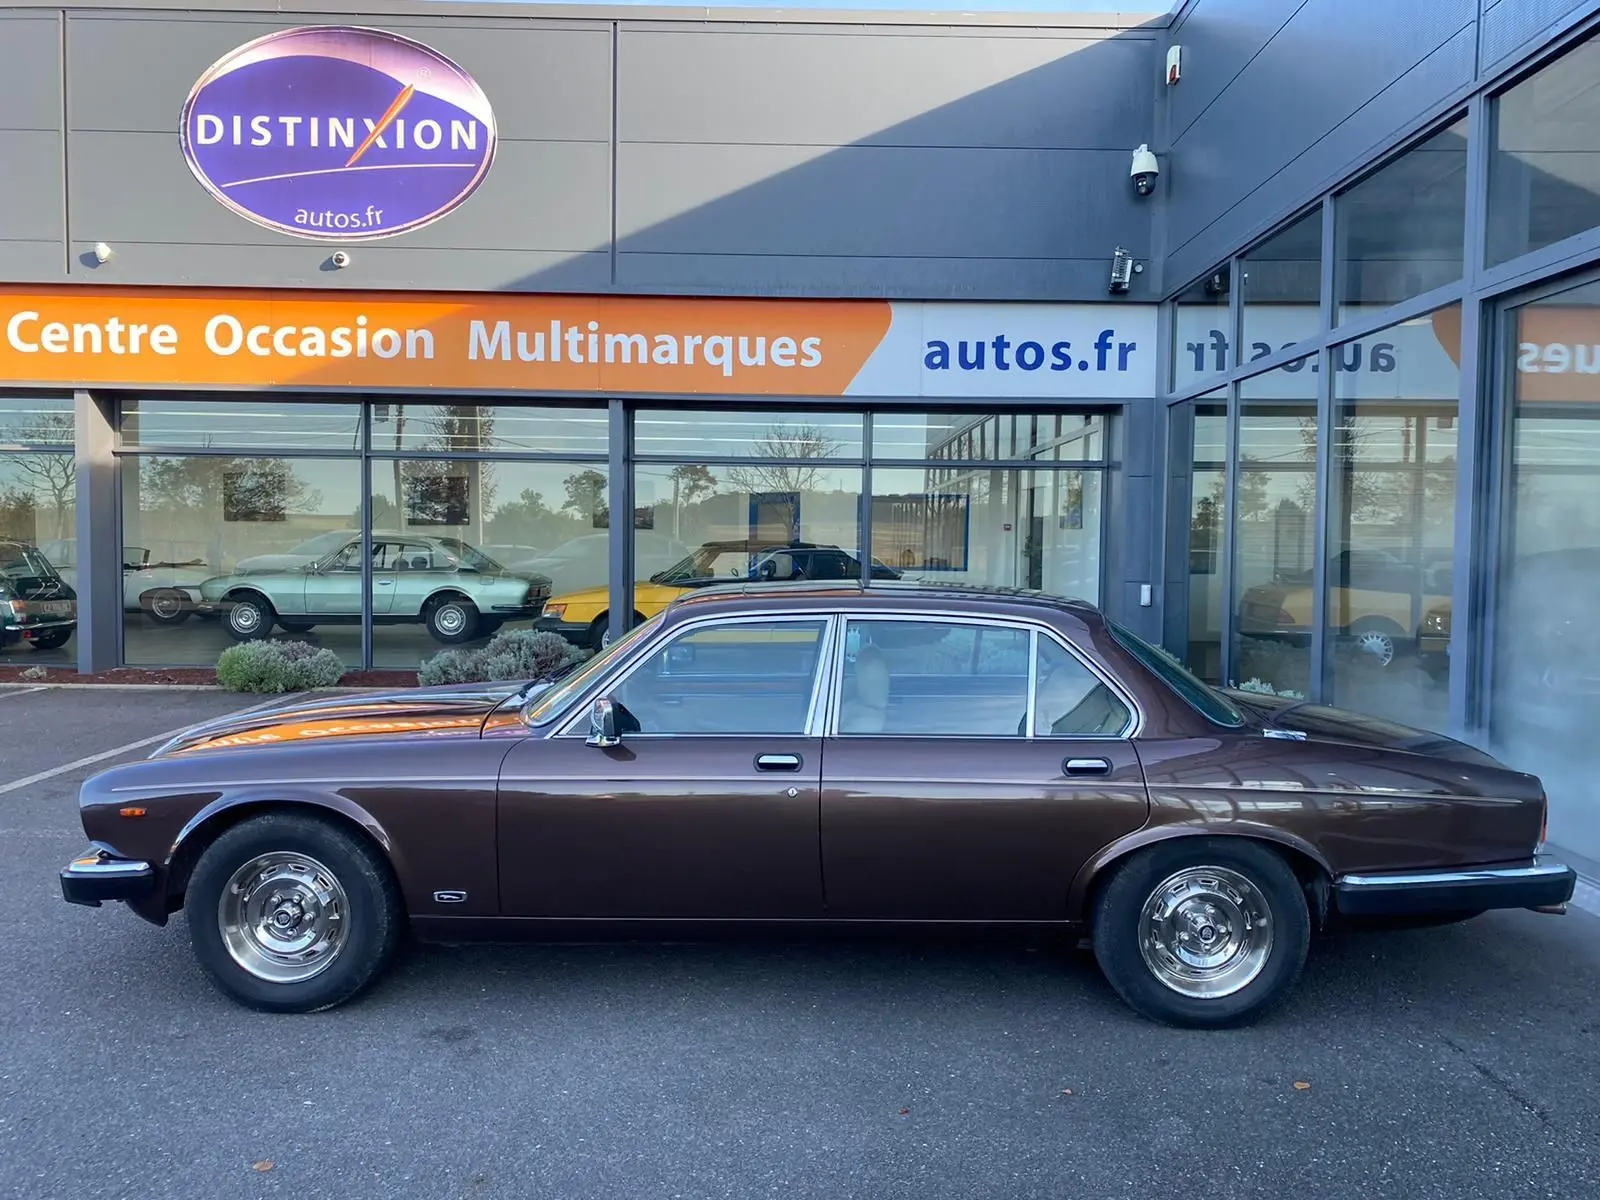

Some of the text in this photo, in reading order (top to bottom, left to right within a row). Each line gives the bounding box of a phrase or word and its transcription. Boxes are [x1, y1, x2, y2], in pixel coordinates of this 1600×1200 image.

[196, 114, 477, 151] DISTINXION
[294, 205, 384, 229] autos.fr
[6, 311, 823, 377] Centre Occasion Multimarques
[924, 329, 1137, 372] autos.fr
